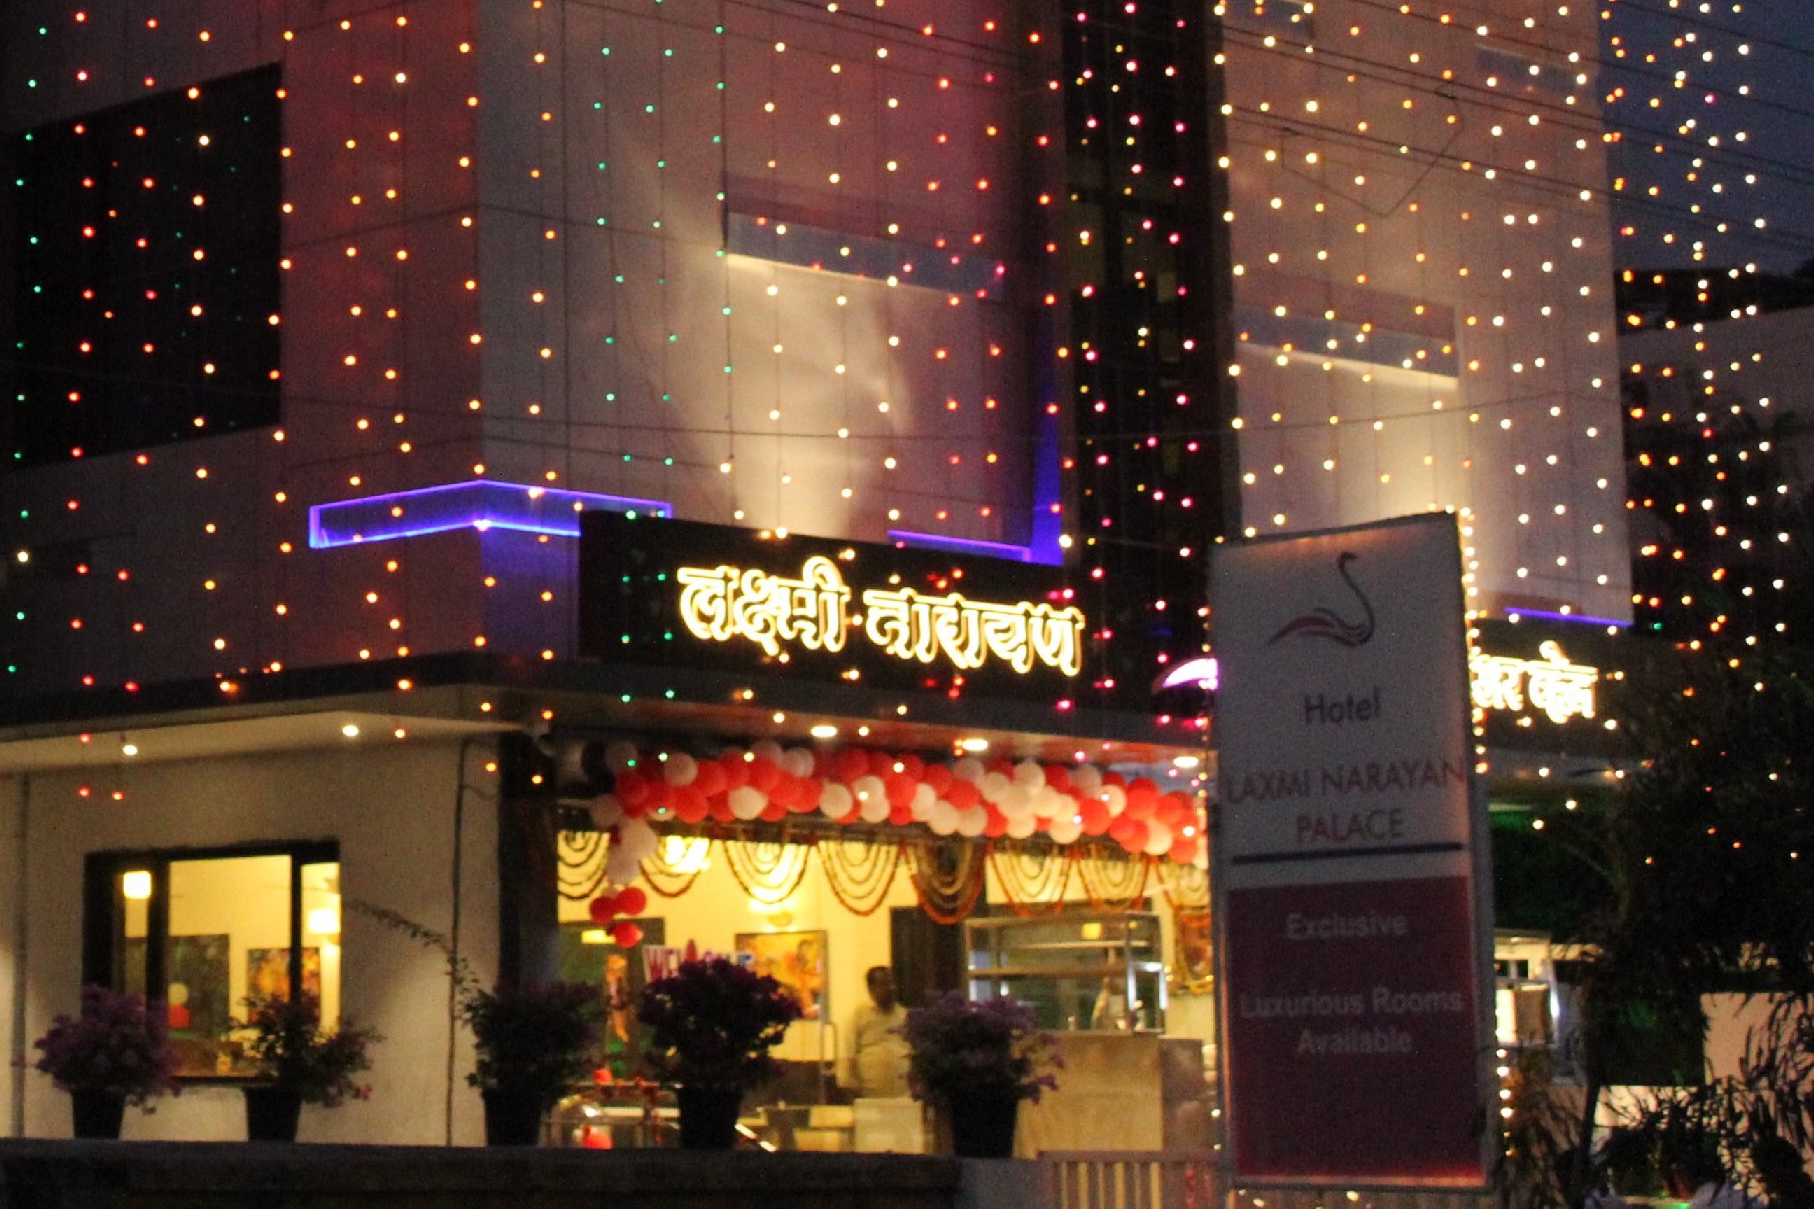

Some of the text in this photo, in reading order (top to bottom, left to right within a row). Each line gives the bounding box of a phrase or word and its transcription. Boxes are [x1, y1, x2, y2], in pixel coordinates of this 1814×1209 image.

[677, 555, 1085, 677] लक्ष्मी नारायण
[1303, 686, 1382, 726] Hotel
[1224, 757, 1465, 804] LAXMI NARAYAN
[1296, 808, 1405, 842] PALACE
[1286, 911, 1408, 940] Exclusive
[1239, 986, 1465, 1018] Luxurious Rooms
[1296, 1027, 1414, 1055] Available
